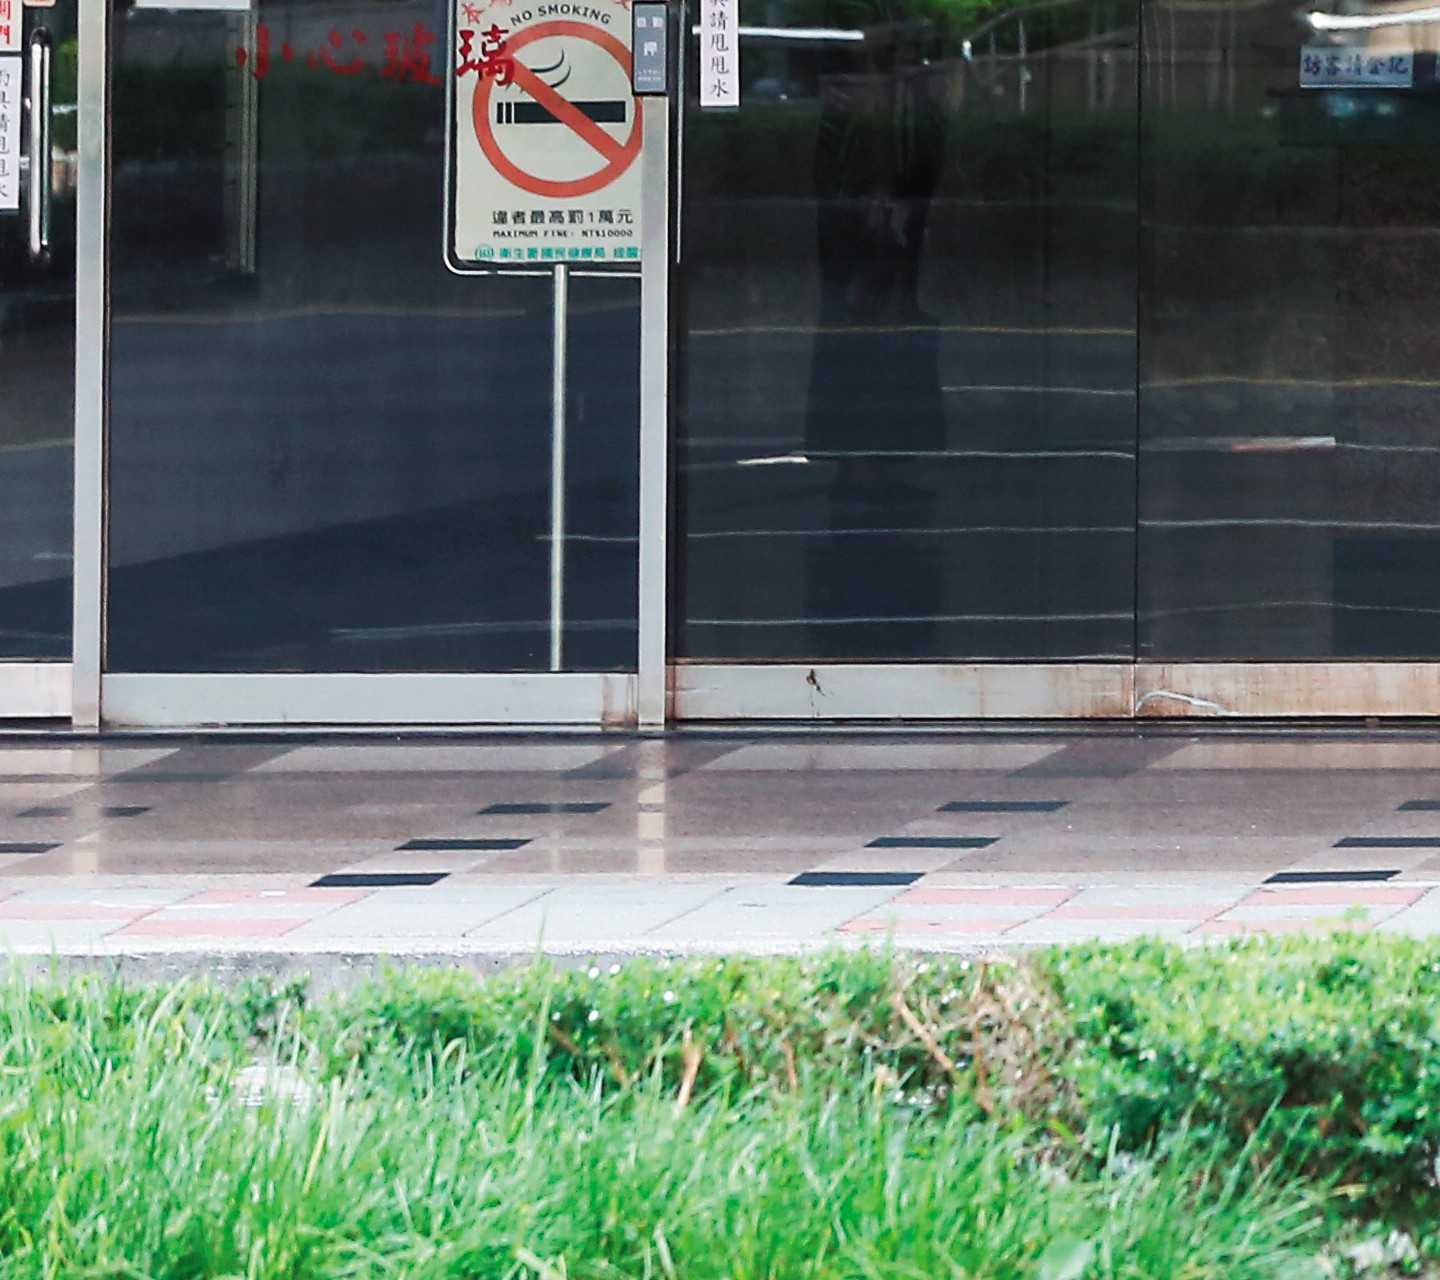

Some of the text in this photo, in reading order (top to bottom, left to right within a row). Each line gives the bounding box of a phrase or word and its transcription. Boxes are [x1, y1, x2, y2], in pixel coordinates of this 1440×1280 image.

[511, 3, 612, 27] NO SMOKING
[235, 22, 516, 86] 小心玻璃
[493, 229, 538, 238] MAXIMUM
